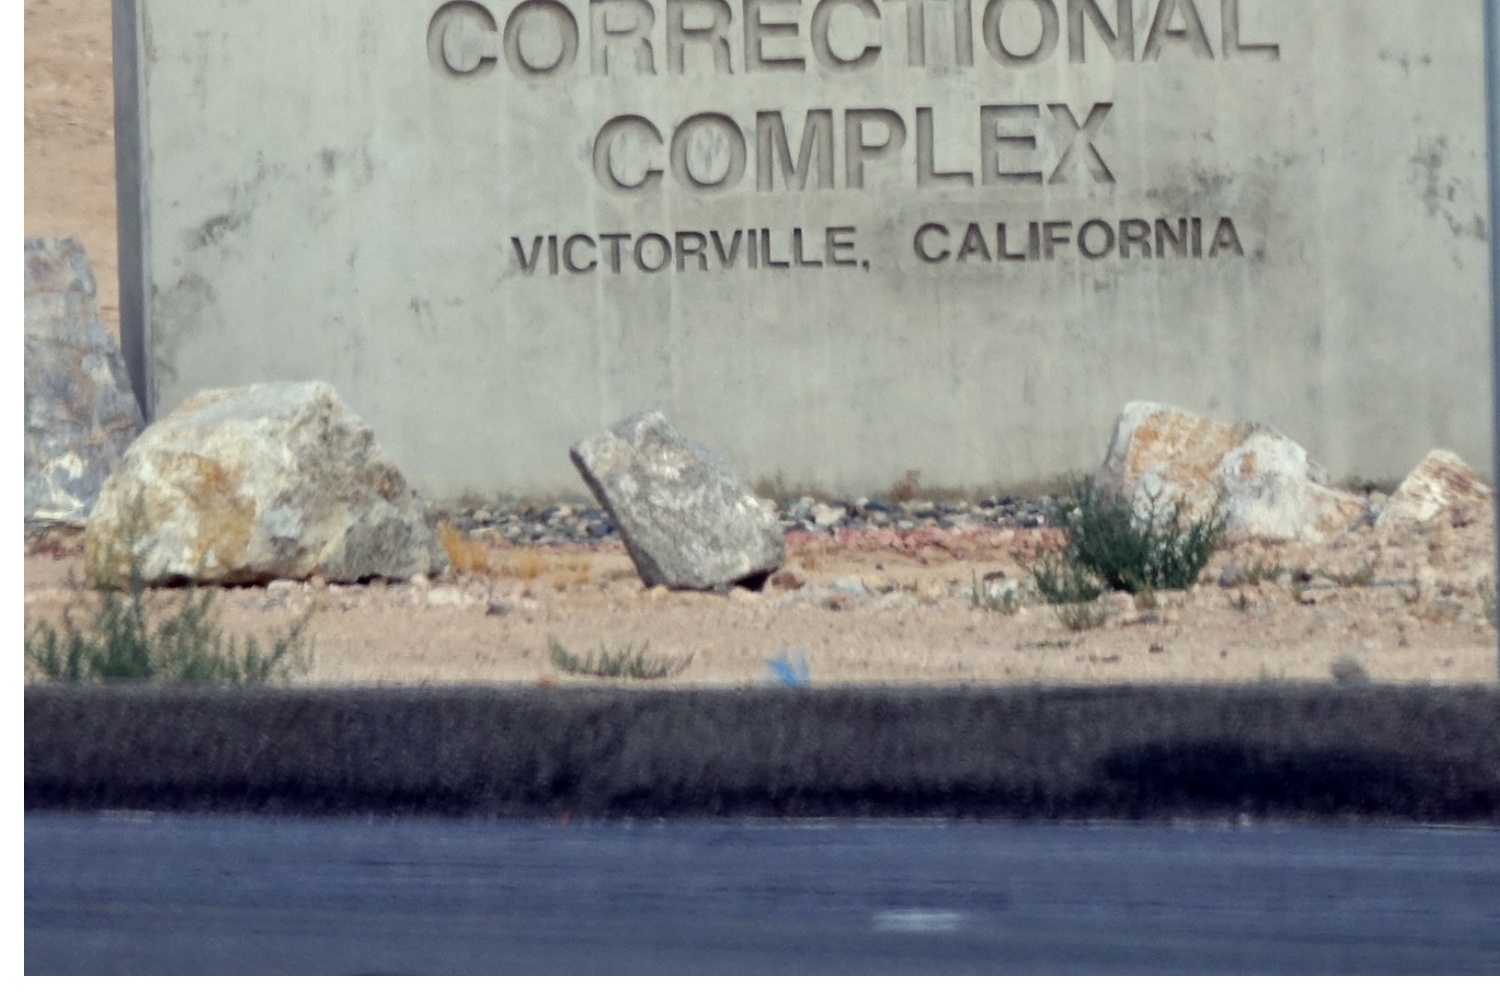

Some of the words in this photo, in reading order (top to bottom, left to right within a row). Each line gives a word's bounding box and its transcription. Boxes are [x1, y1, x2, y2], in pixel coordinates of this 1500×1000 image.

[592, 101, 1117, 193] COMPLEX
[510, 225, 871, 276] VICTORVILLE,
[913, 216, 1245, 265] CALIFORNIA
